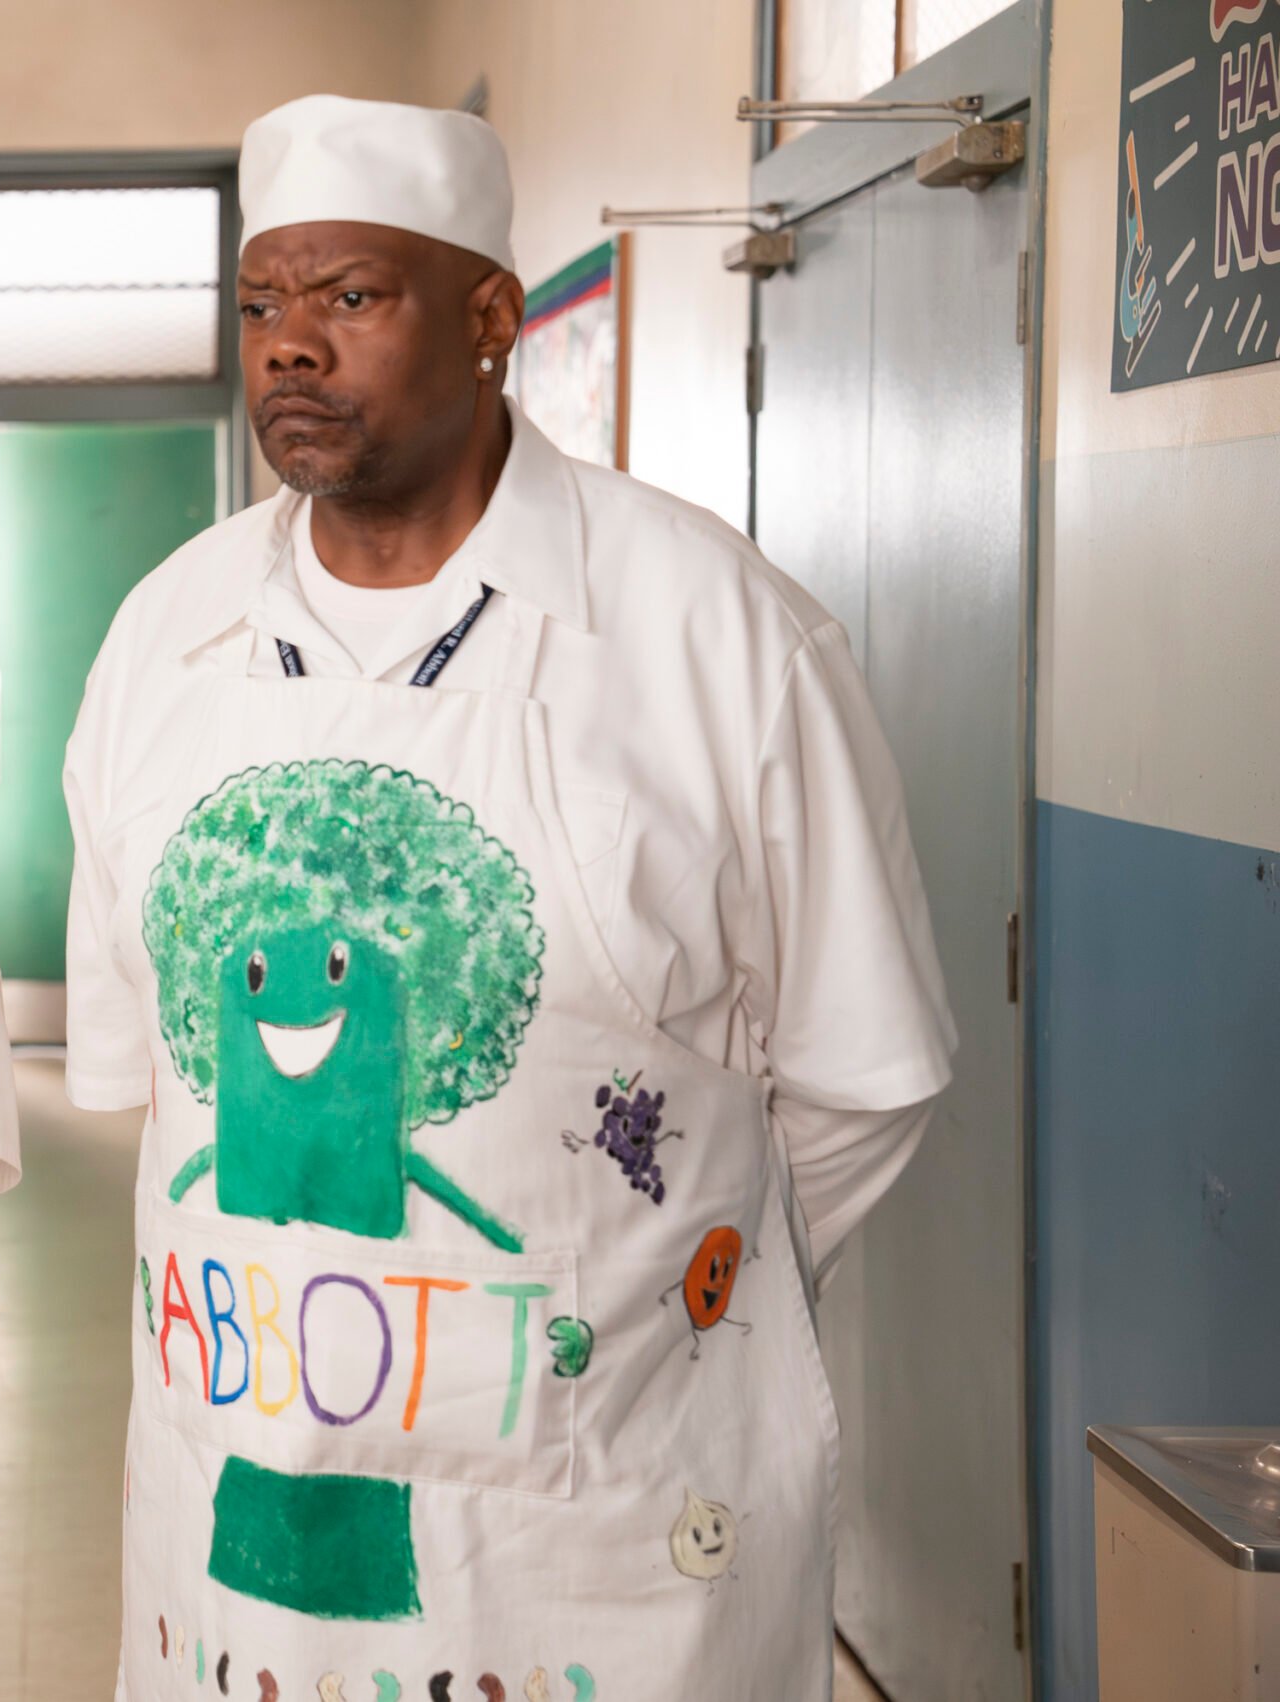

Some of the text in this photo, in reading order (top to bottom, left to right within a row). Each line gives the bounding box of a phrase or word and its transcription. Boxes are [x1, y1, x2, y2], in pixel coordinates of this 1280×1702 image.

[1218, 32, 1280, 140] HA
[416, 648, 447, 685] Abbott
[160, 1251, 554, 1439] ABBOTT
